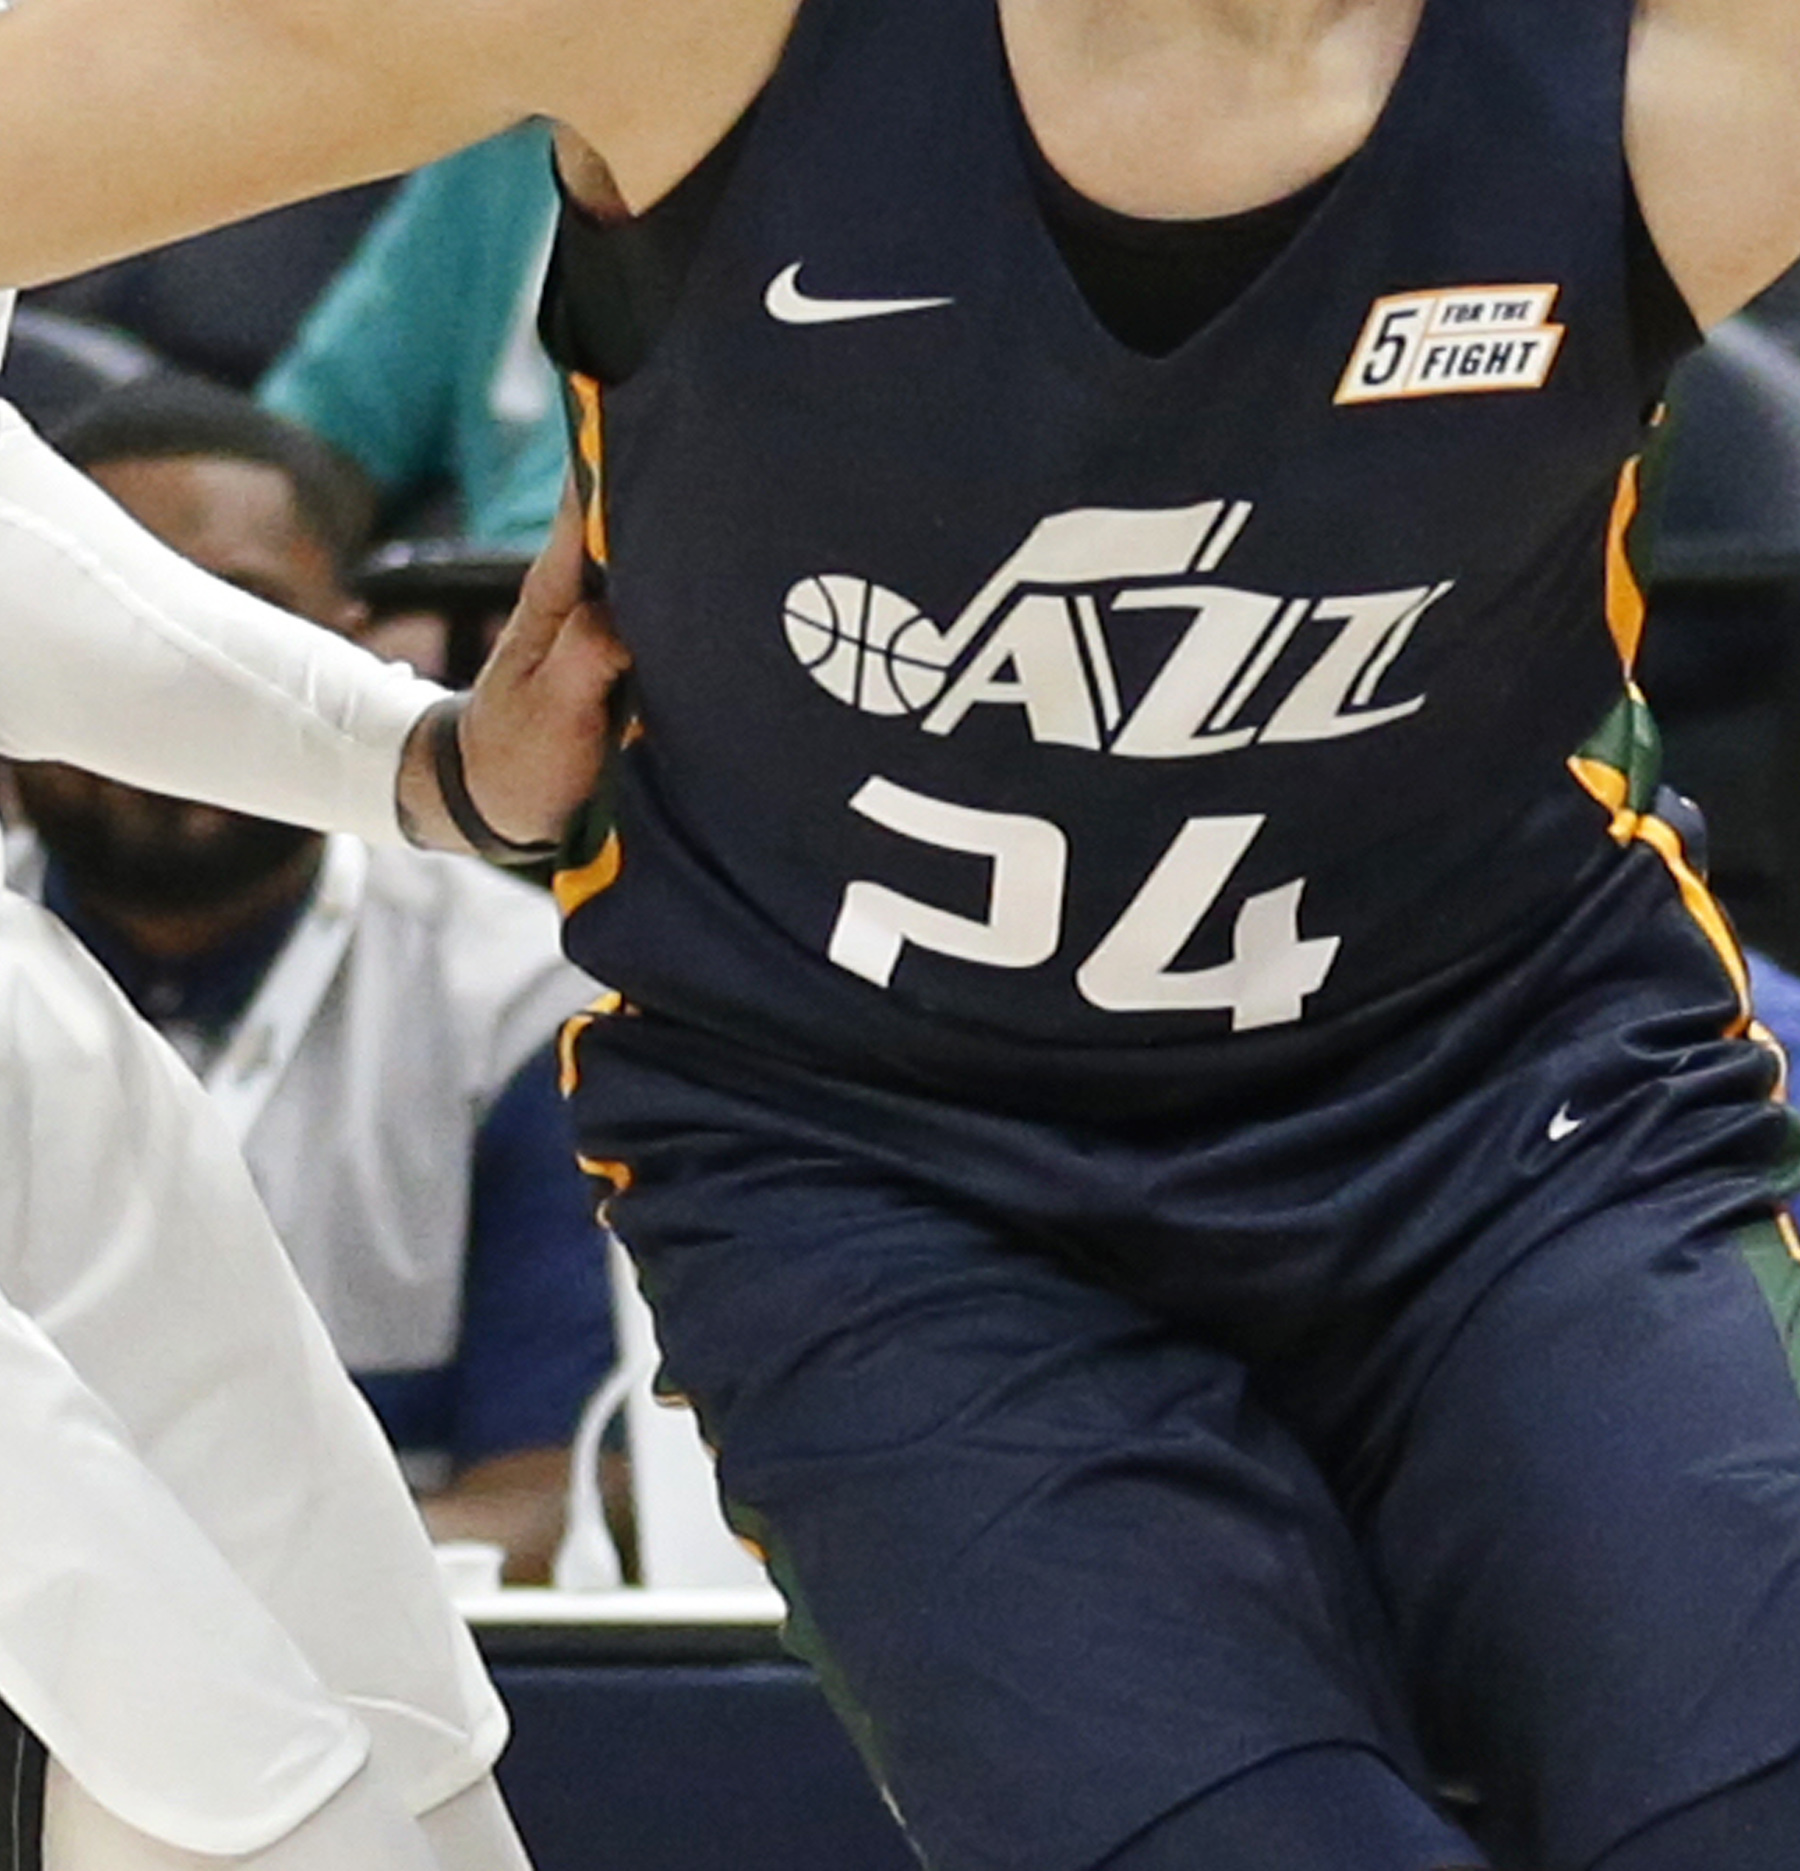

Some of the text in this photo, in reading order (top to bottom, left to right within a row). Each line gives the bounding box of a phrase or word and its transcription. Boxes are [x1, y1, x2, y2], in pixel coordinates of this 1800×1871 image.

[1361, 308, 1419, 387] 5
[1441, 299, 1534, 325] FOR THE
[1419, 338, 1541, 381] FIGHT
[782, 499, 1456, 759] JAZZ
[826, 773, 1342, 1032] 24
